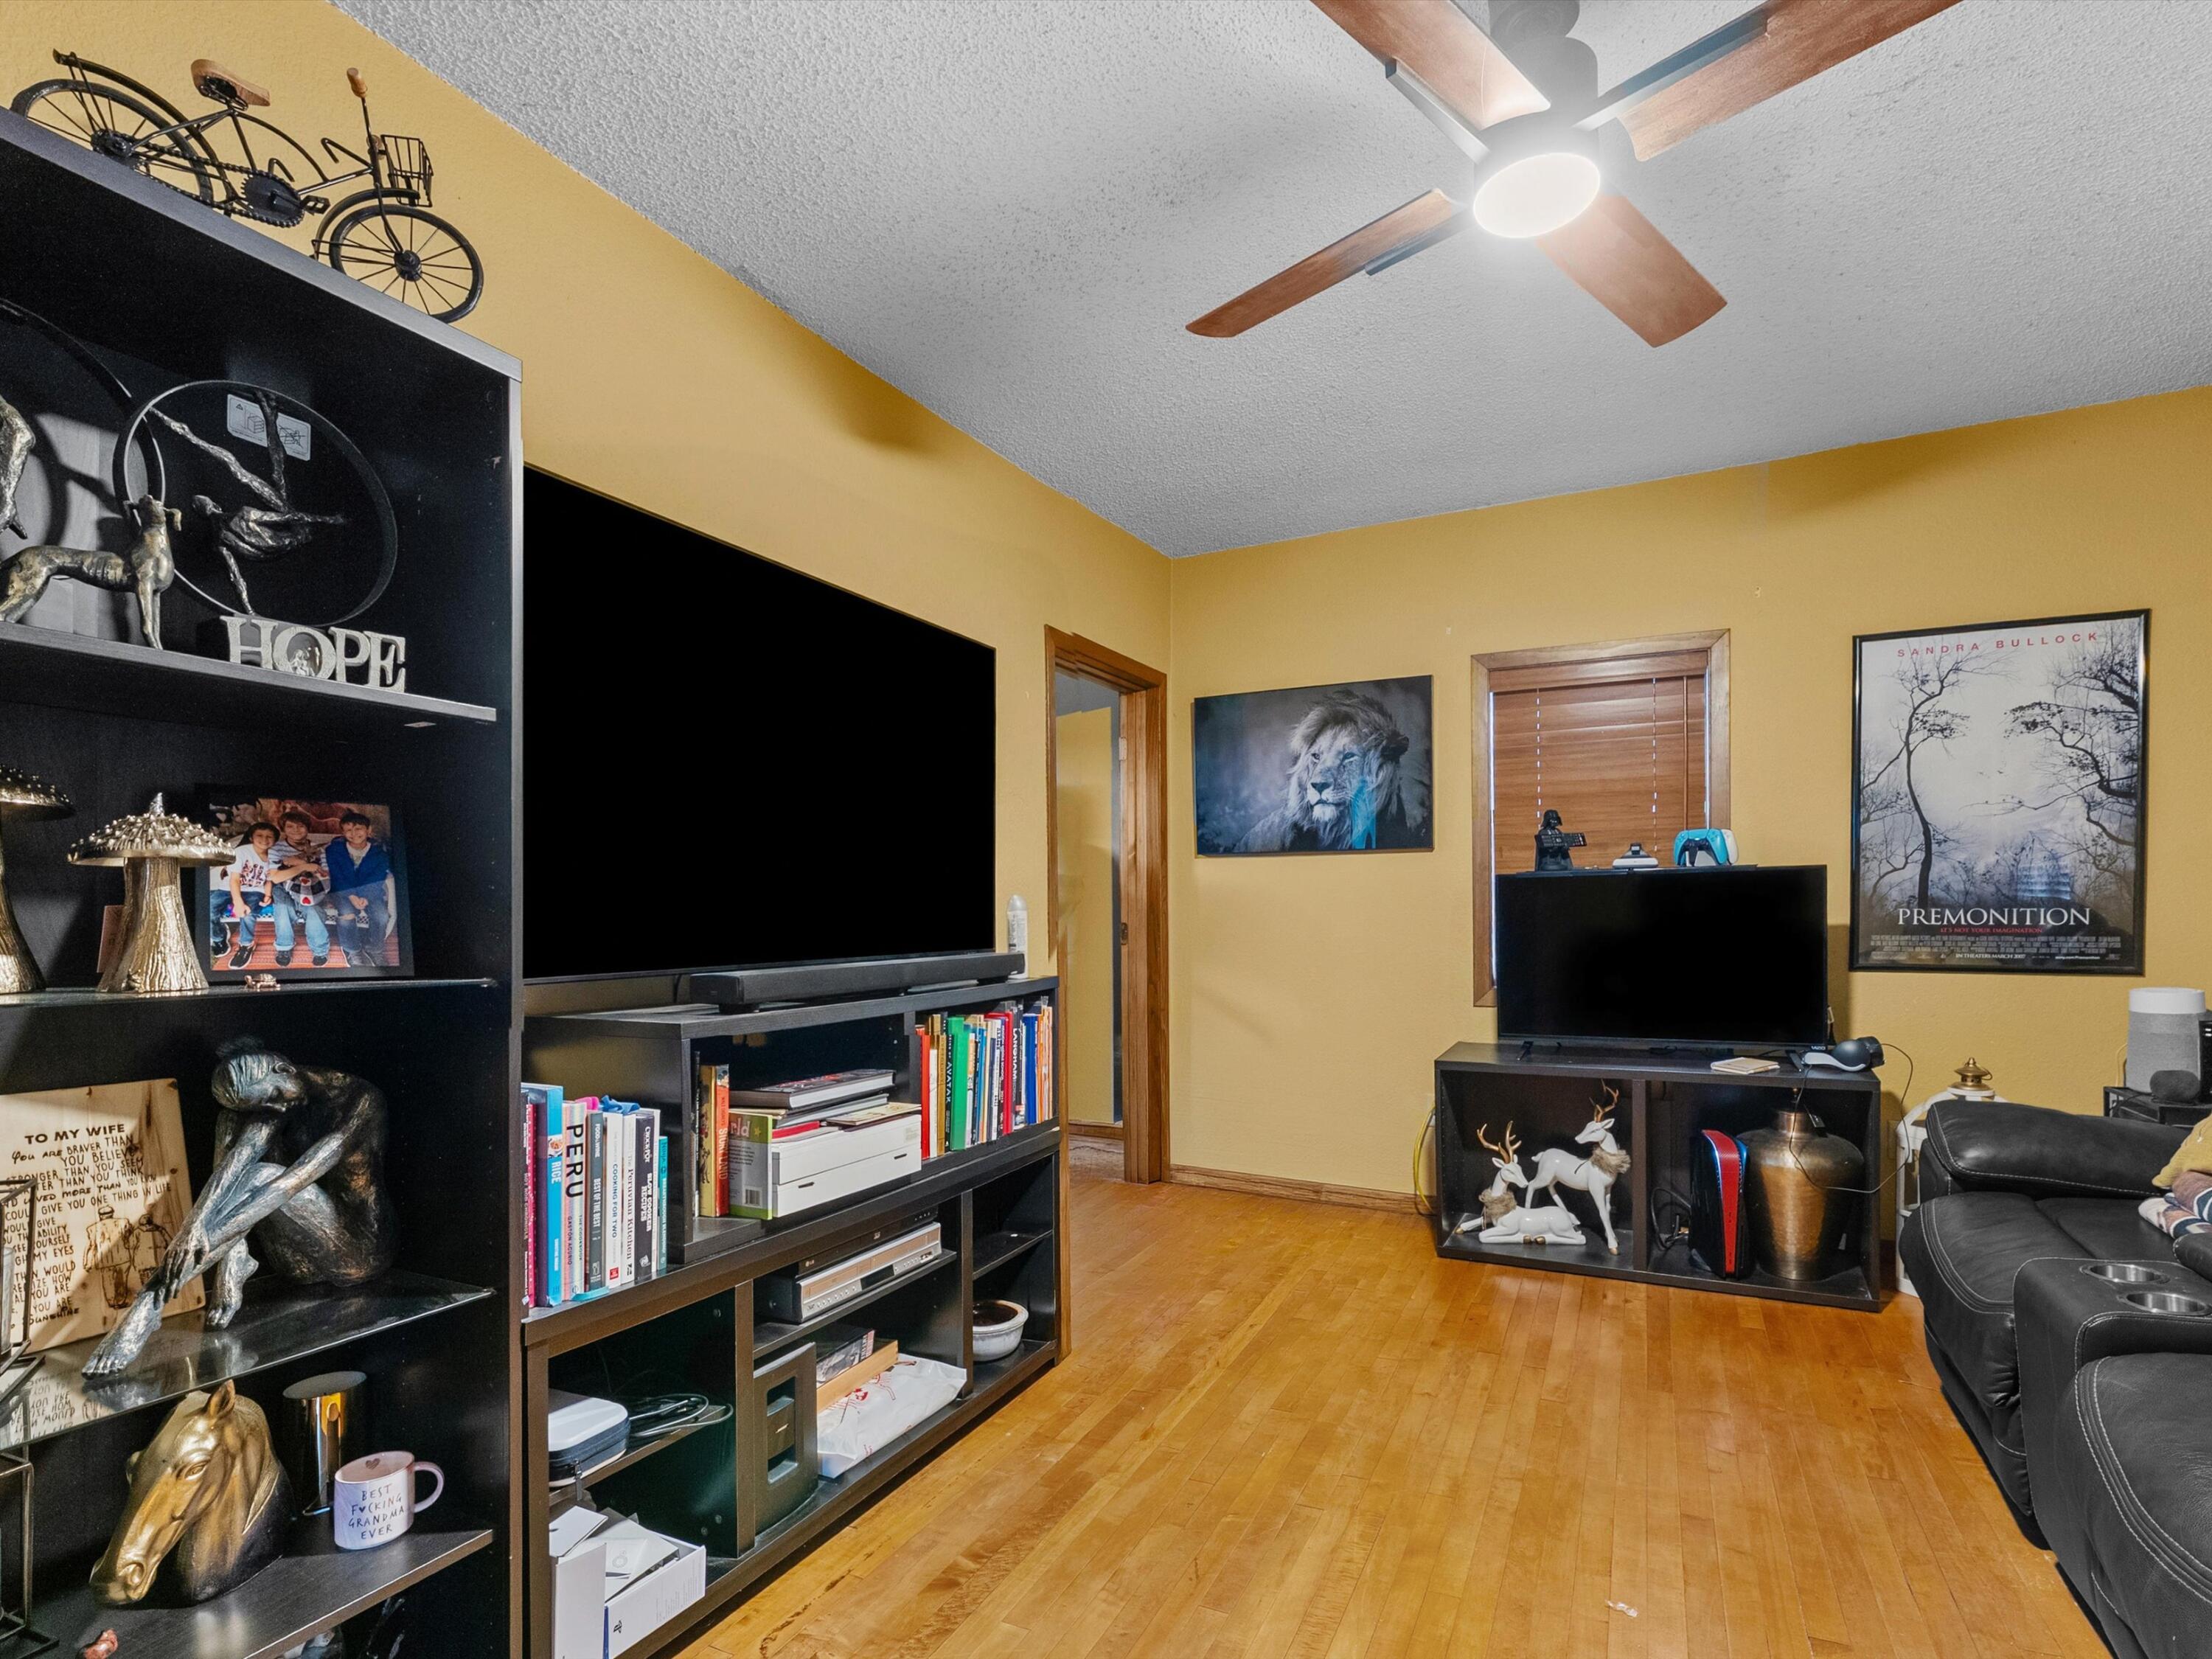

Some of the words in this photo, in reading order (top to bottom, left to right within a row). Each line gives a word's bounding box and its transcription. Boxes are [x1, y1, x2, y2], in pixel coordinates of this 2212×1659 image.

[220, 615, 406, 693] HOPE
[1897, 643, 1980, 657] SANDRA
[1996, 632, 2098, 649] BULLOCK
[1897, 908, 2090, 925] PREMONITION
[1992, 926, 2042, 934] IMAGINATION
[24, 1133, 48, 1144] TO
[54, 1129, 80, 1142] MY
[86, 1124, 125, 1137] WIFE
[730, 1118, 751, 1137] rld
[42, 1150, 63, 1158] ARE
[66, 1142, 101, 1155] BRAVER
[105, 1134, 133, 1147] THAN
[60, 1154, 85, 1167] YOU
[66, 1164, 89, 1176] THAN
[96, 1162, 114, 1175] YOU
[120, 1157, 143, 1169] SEEM
[566, 1124, 584, 1198] PERU
[719, 1155, 728, 1179] LAND
[60, 1177, 85, 1189] THAN
[91, 1172, 109, 1183] YOU
[116, 1166, 143, 1178] THINK
[552, 1161, 562, 1184] RICE
[62, 1188, 91, 1198] MORE
[97, 1182, 121, 1193] THAN
[128, 1178, 138, 1186] YOU
[6, 1208, 29, 1221] COUL
[41, 1203, 63, 1215] GIVE
[68, 1197, 86, 1209] YOU
[91, 1196, 108, 1206] ONE
[112, 1190, 139, 1202] THING
[143, 1186, 152, 1197] IN
[156, 1183, 171, 1194] LIFE
[4, 1222, 27, 1234] WOUL
[37, 1217, 55, 1228] GIVE
[18, 1233, 28, 1241] TH
[38, 1224, 67, 1239] ABILITY
[35, 1234, 70, 1248] OURSELF
[33, 1251, 47, 1261] MY
[53, 1245, 74, 1257] EYES
[15, 1270, 38, 1282] THN
[44, 1261, 76, 1276] WOULD
[52, 1272, 72, 1285] HOW
[31, 1287, 49, 1300] YOU
[55, 1283, 69, 1295] ARE
[32, 1301, 51, 1314] YOU
[57, 1296, 72, 1308] ARE
[361, 1483, 393, 1501] BEST
[348, 1506, 405, 1528] GRANDMA
[361, 1524, 392, 1540] EVER
